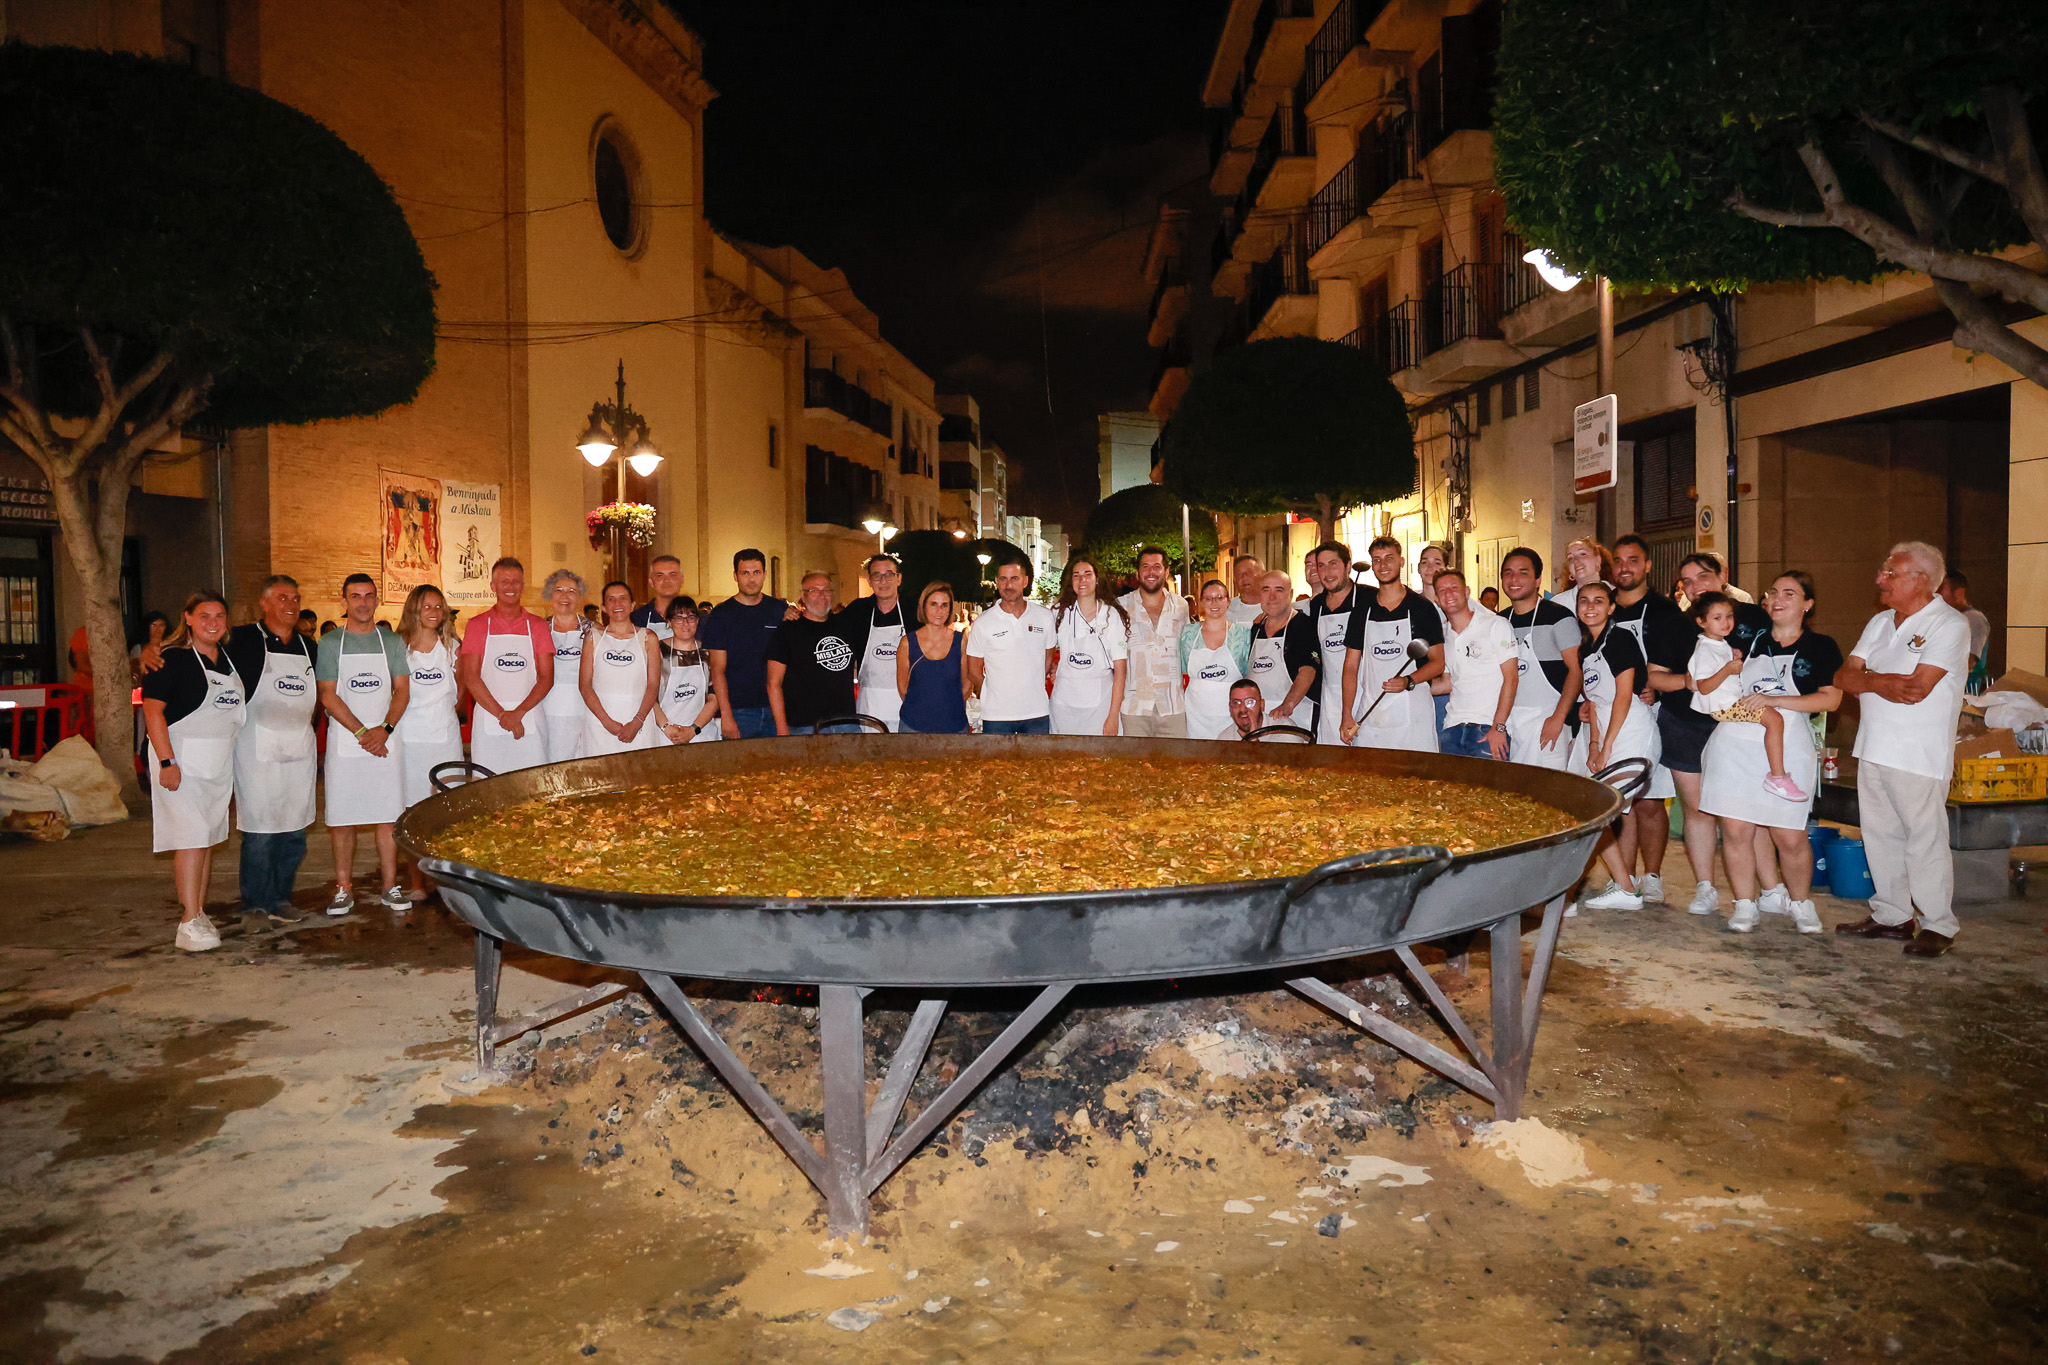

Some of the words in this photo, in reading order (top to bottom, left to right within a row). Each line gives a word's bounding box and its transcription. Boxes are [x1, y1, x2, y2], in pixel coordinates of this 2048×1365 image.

[447, 486, 496, 502] Benvinguda
[451, 505, 458, 514] a
[459, 503, 491, 516] Mislata
[388, 581, 418, 593] DESAMP
[1325, 640, 1344, 648] Dacs
[816, 646, 852, 661] MISLATA
[1374, 646, 1401, 655] Dacsa
[606, 652, 632, 662] Dacsa
[497, 658, 525, 667] Dacsa
[415, 671, 442, 680] Dacsa
[1201, 669, 1226, 679] Dacsa
[350, 679, 380, 688] Dacsa
[1585, 673, 1599, 686] acsa
[278, 680, 305, 691] Dacsa
